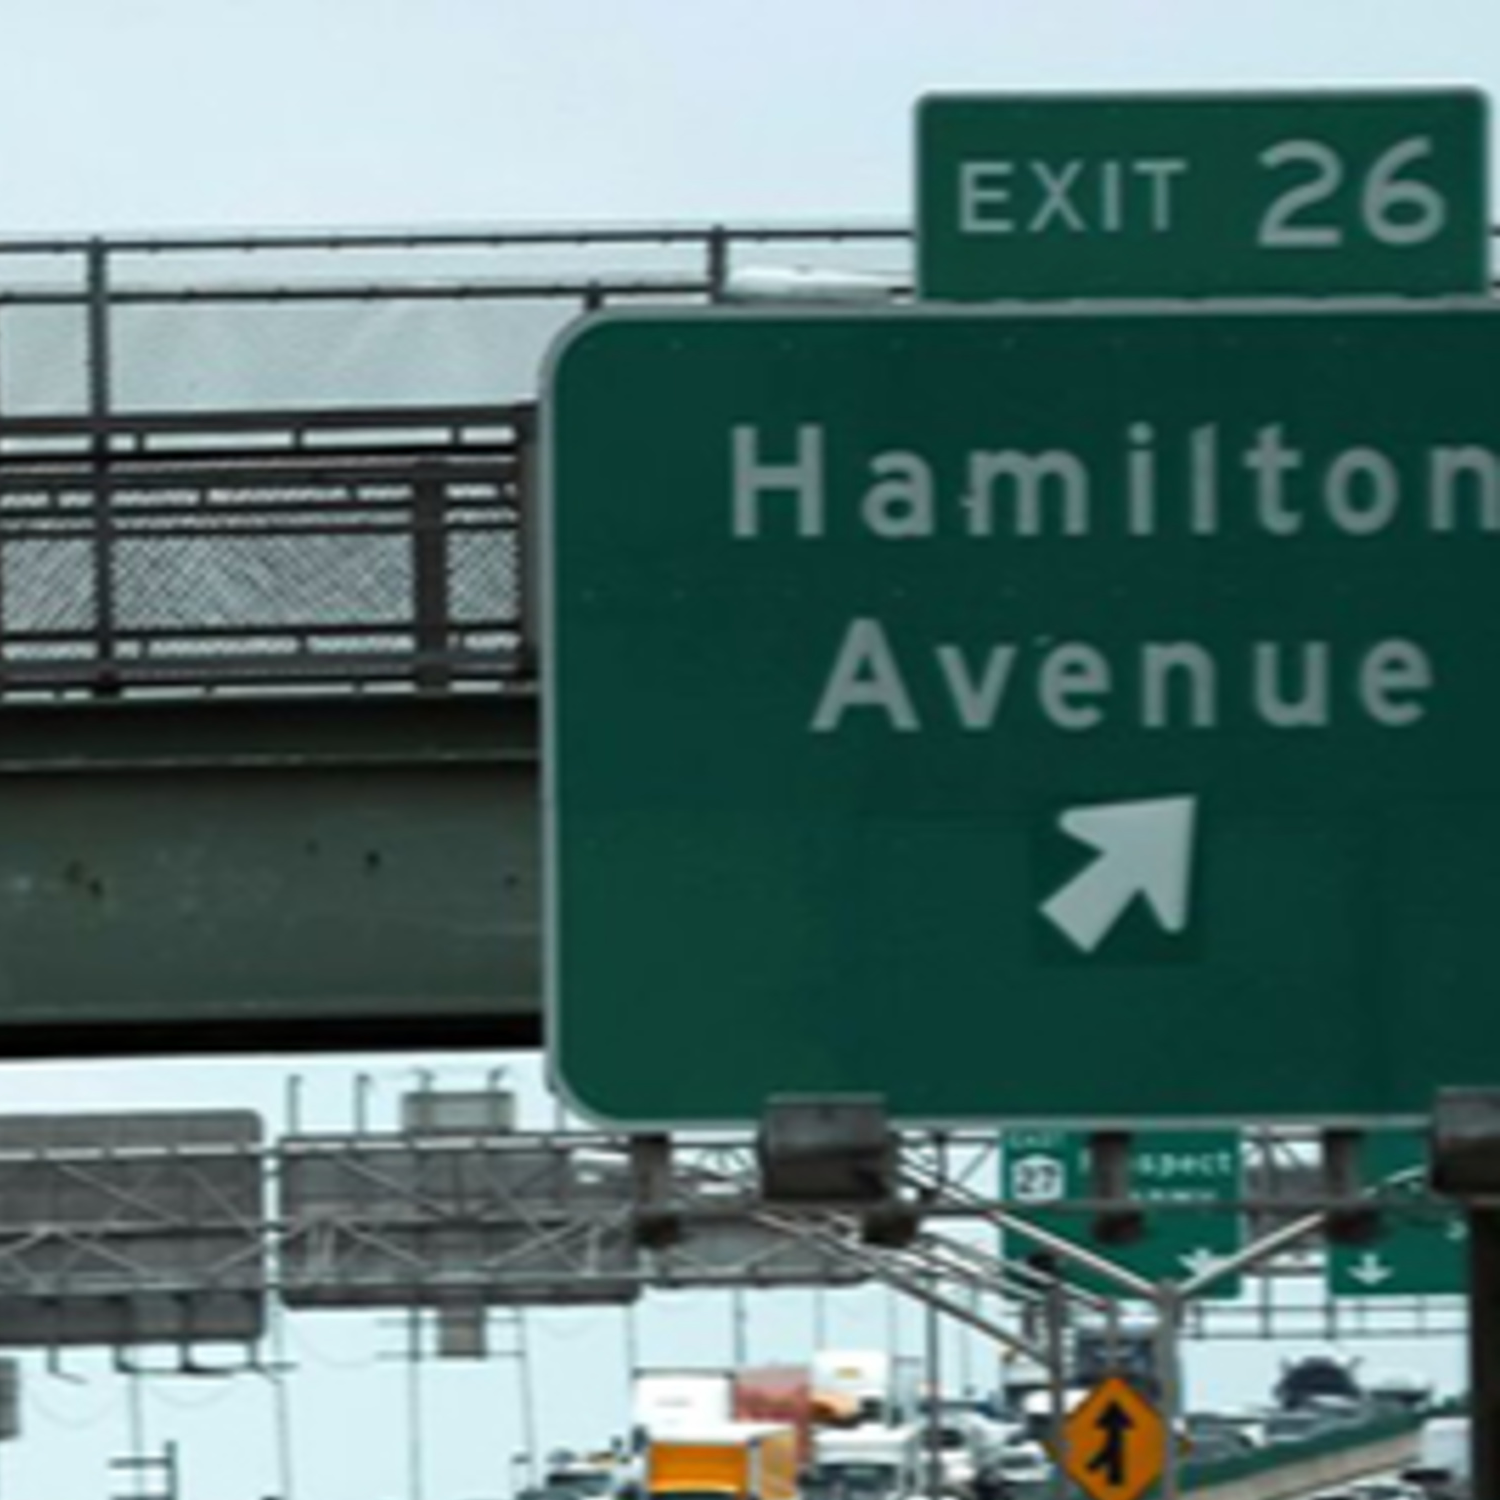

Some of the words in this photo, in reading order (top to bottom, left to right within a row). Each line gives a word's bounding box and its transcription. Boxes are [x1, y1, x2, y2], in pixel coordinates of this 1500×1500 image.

[958, 158, 1187, 234] EXIT
[1257, 136, 1445, 248] 26
[731, 422, 1500, 539] Hamilton
[810, 617, 1432, 732] Avenue
